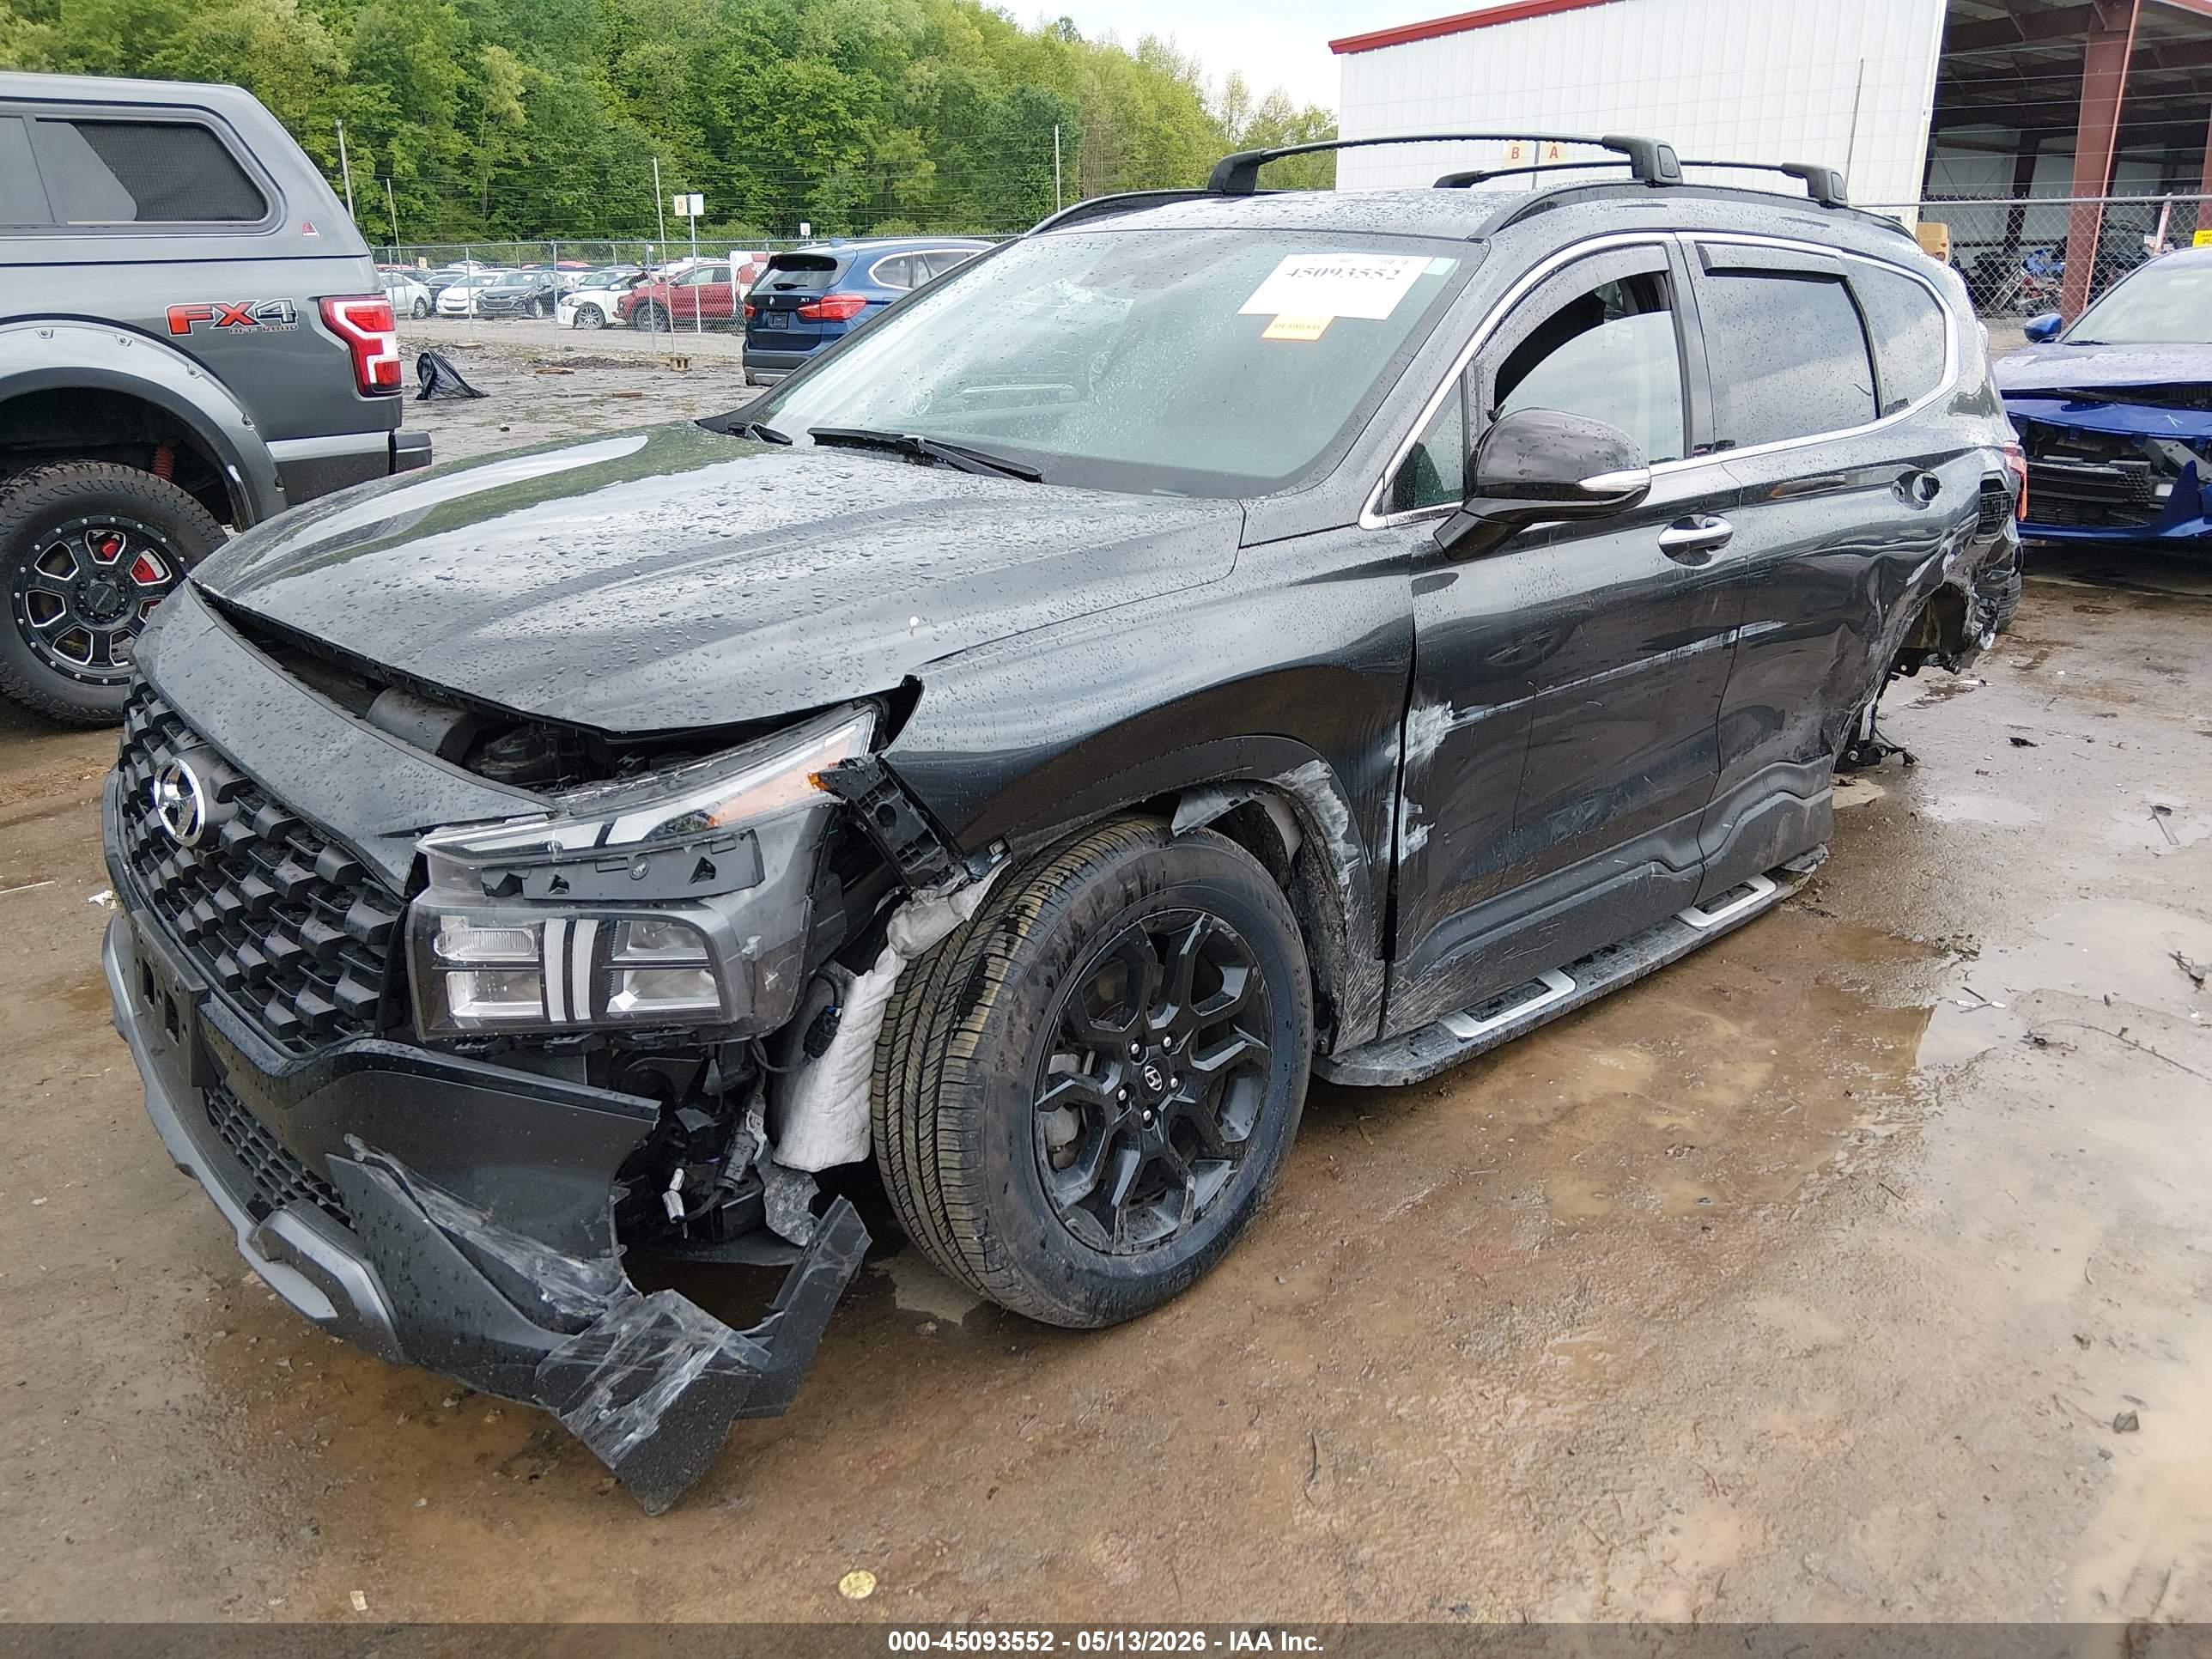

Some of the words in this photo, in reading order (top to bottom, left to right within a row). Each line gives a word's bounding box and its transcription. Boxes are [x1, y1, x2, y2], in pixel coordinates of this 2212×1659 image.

[1511, 146, 1520, 160] B
[1549, 146, 1559, 159] A
[1286, 267, 1401, 280] 45093552
[166, 299, 297, 336] FX4
[229, 325, 258, 335] OFF
